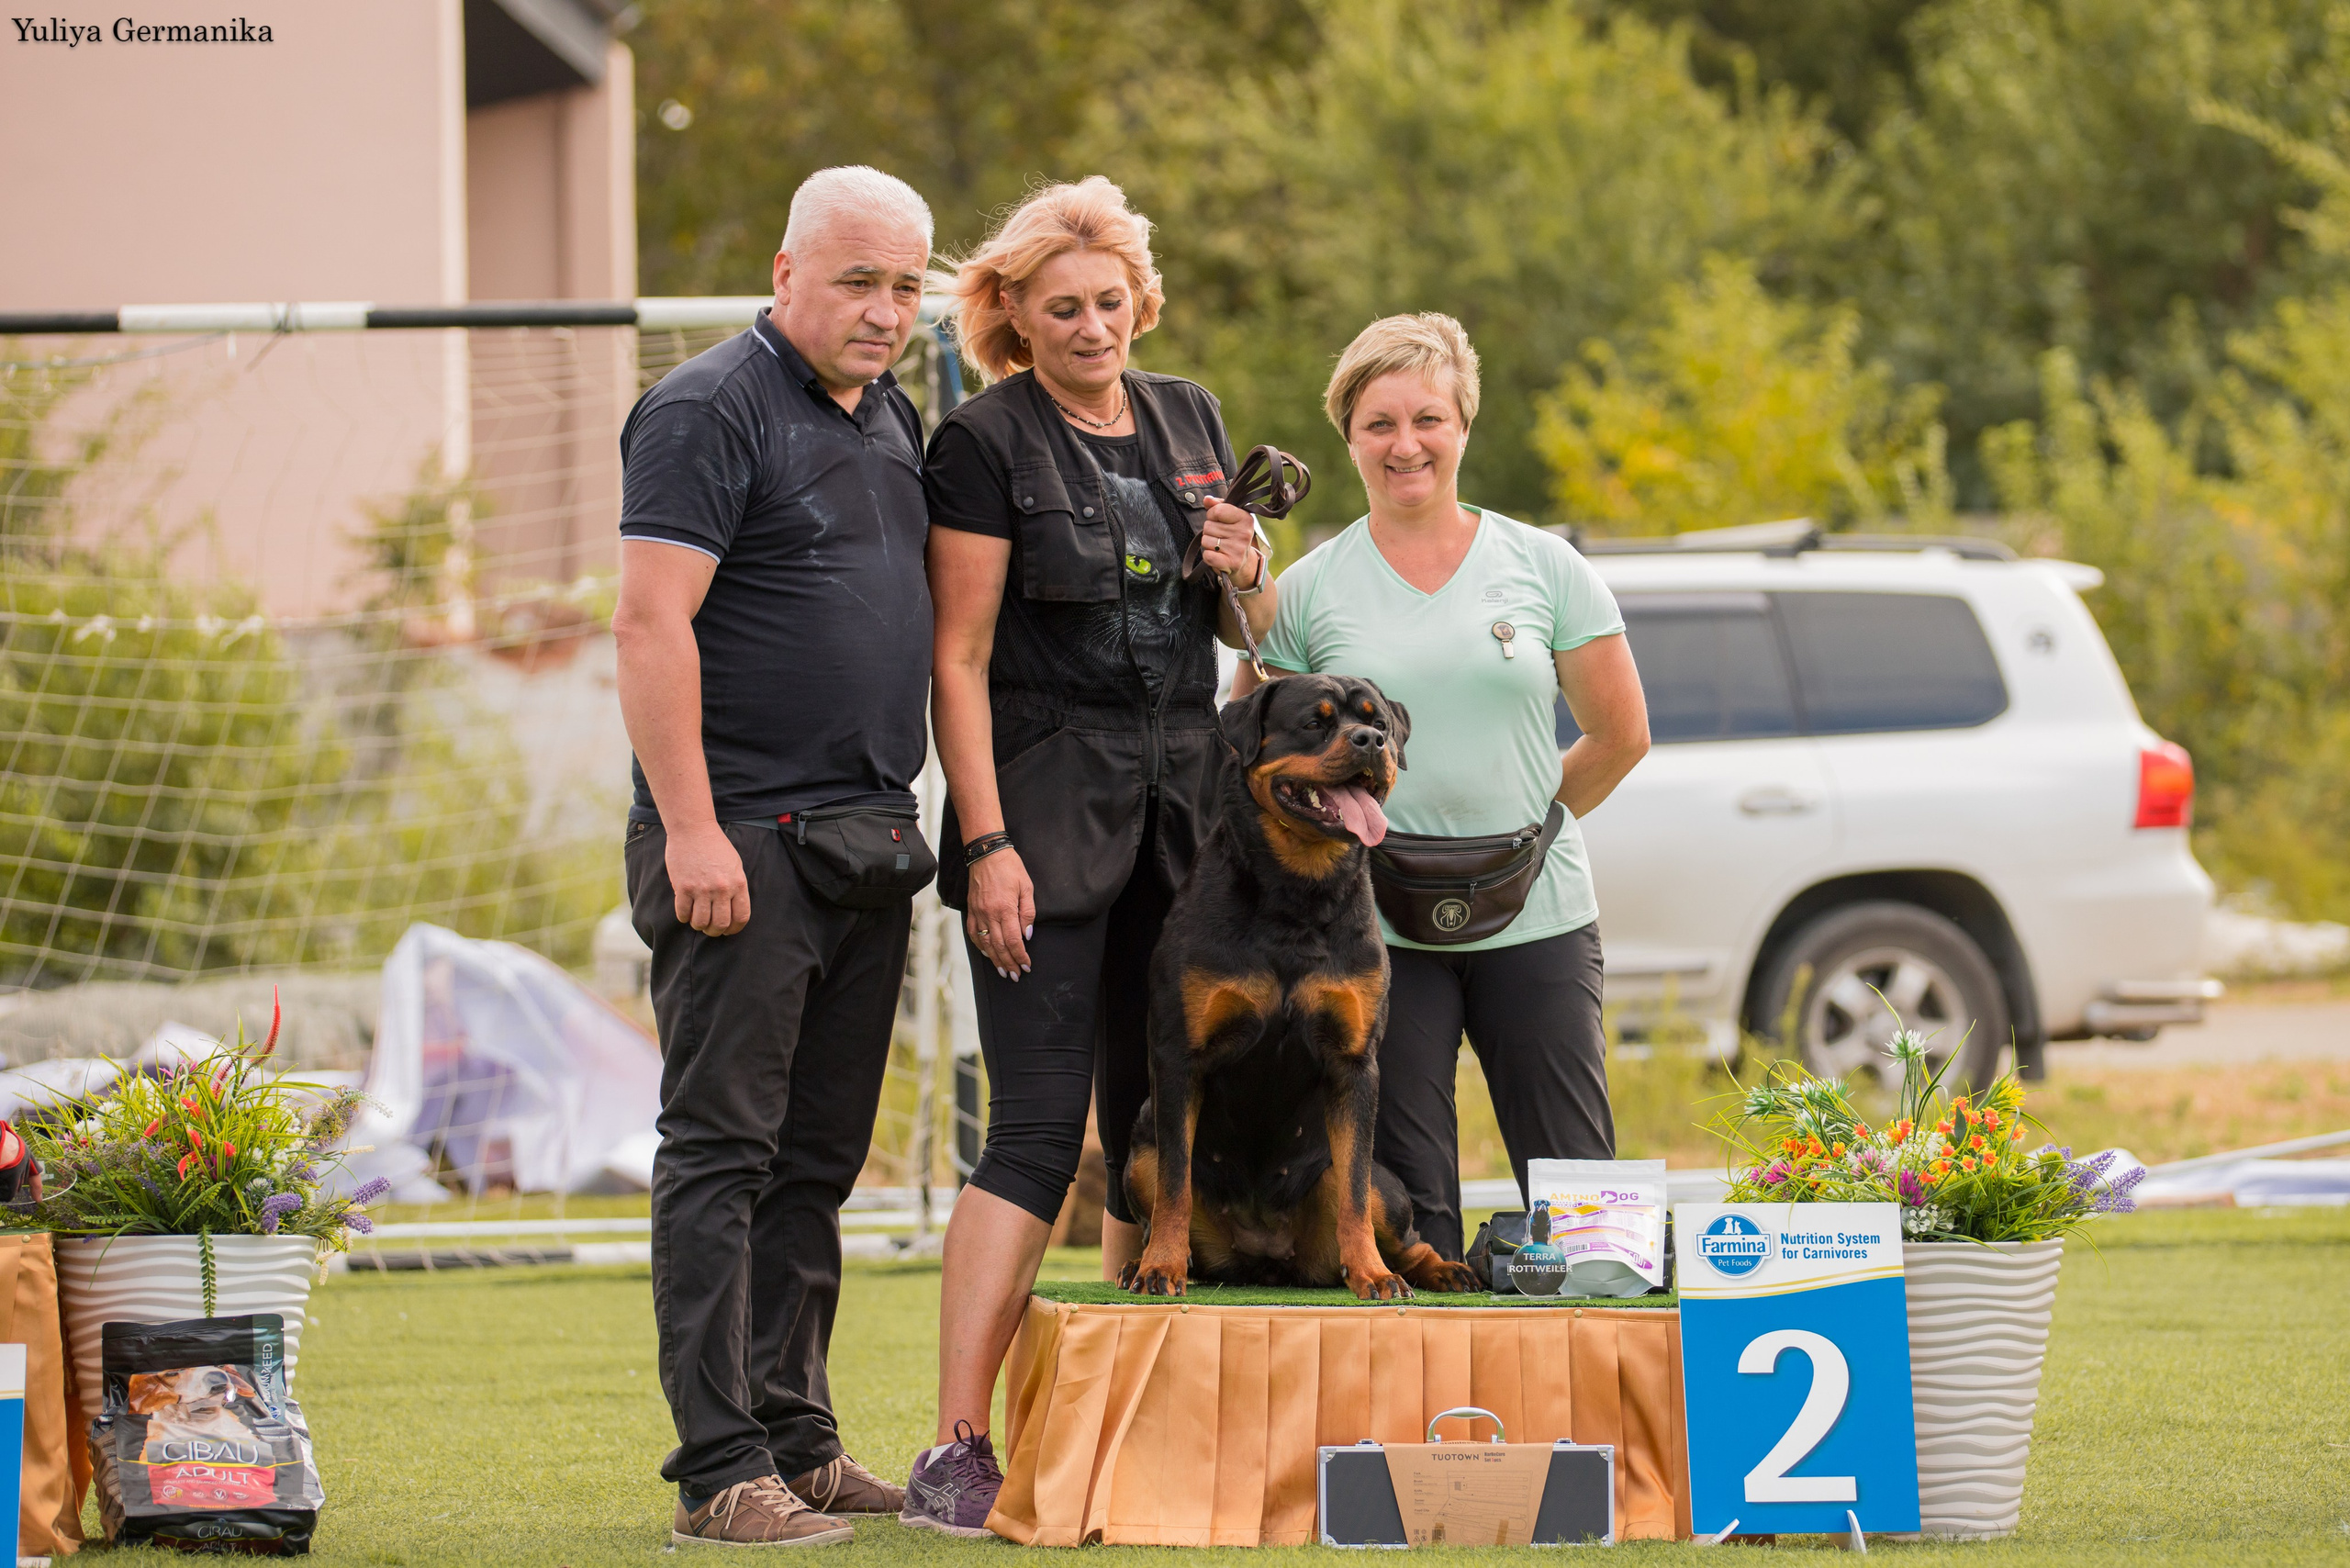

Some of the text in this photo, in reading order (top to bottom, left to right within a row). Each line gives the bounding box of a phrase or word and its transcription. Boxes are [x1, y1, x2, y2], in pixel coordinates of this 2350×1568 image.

[1702, 1238, 1766, 1254] Farmina
[1781, 1232, 1881, 1247] Nutrition System
[1523, 1252, 1557, 1261] TERRA
[1782, 1247, 1868, 1260] for Carnivores
[1509, 1264, 1573, 1273] ROTTWEILER
[1731, 1259, 1752, 1267] Foods
[1737, 1328, 1858, 1503] 2
[162, 1440, 260, 1465] CIBAU
[1432, 1453, 1480, 1462] TUOTOWN
[175, 1466, 252, 1485] ADULT
